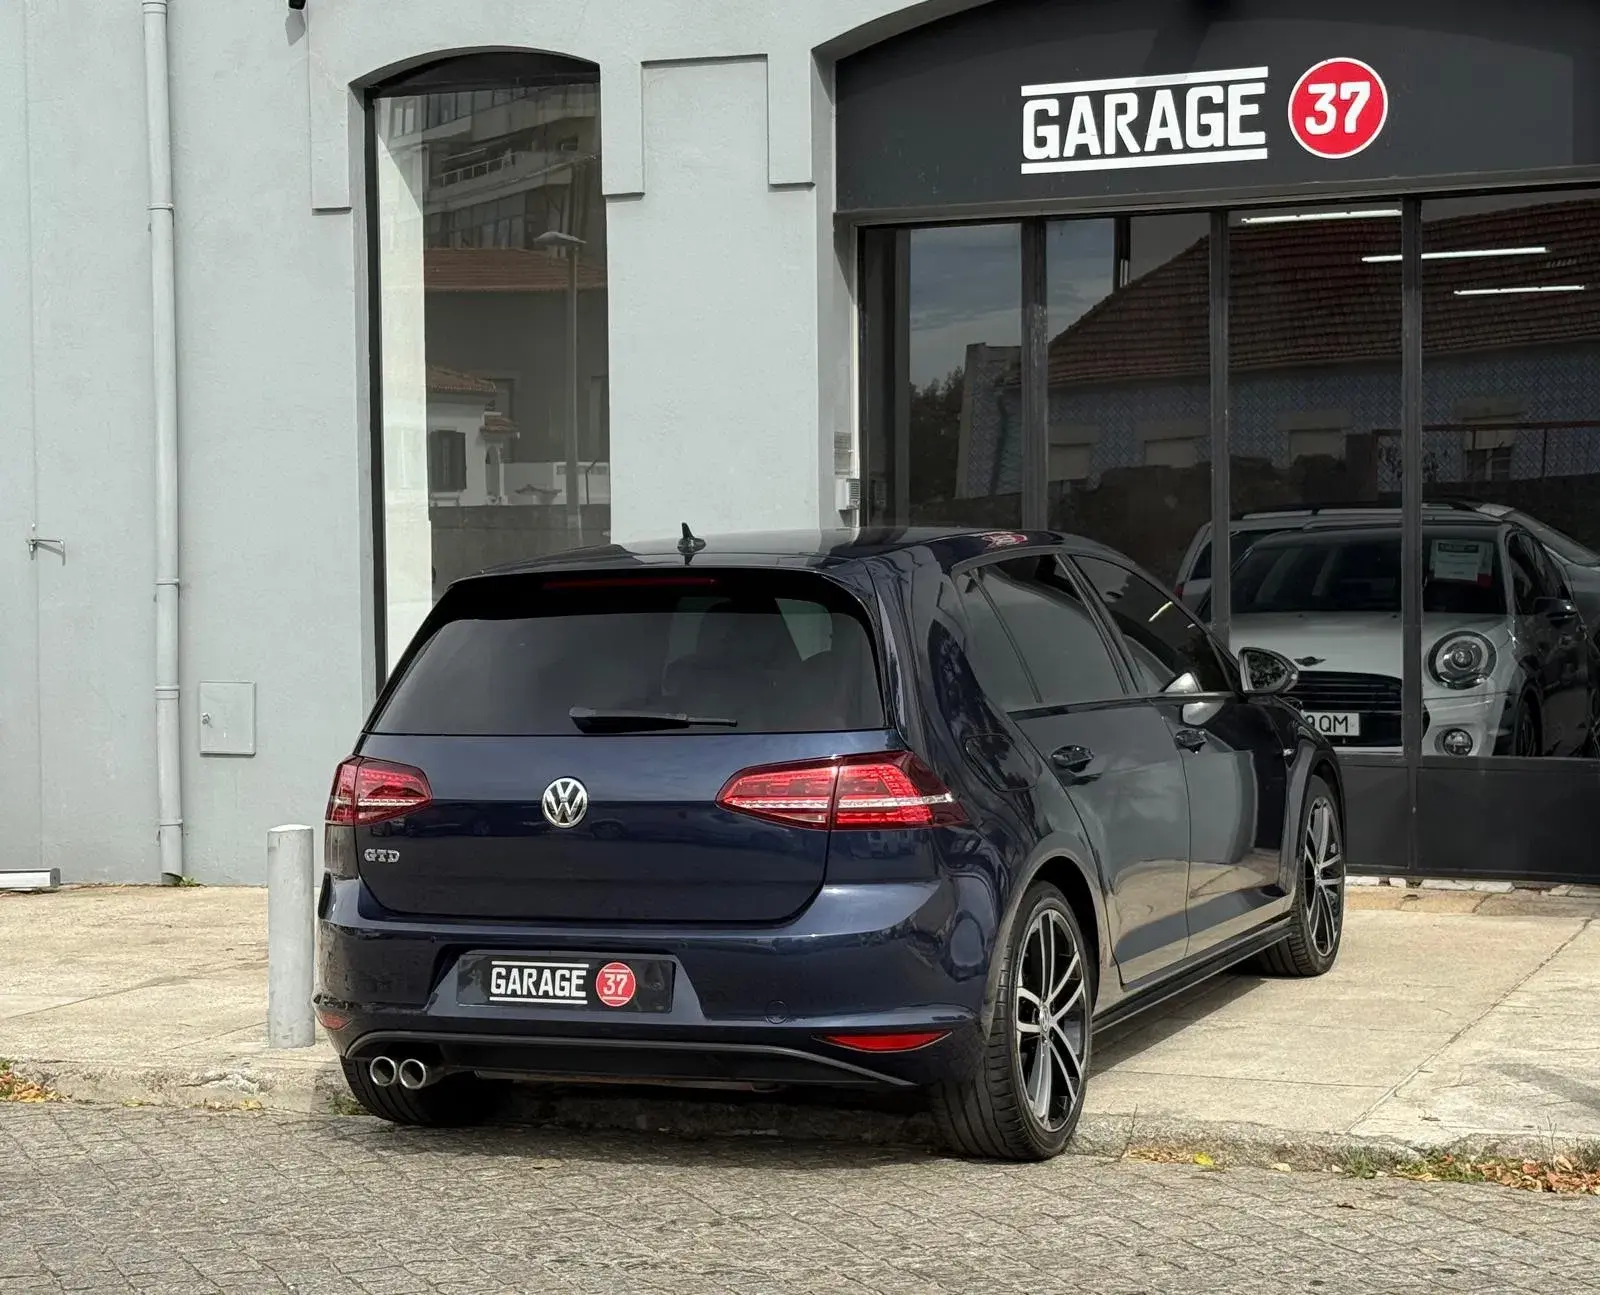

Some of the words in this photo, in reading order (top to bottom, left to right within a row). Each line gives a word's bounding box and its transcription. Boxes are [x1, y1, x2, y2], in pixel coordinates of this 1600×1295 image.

[1022, 82, 1266, 160] GARAGE
[1304, 81, 1371, 136] 37
[364, 848, 400, 863] GTD
[490, 967, 587, 998] GARAGE
[603, 973, 628, 995] 37
